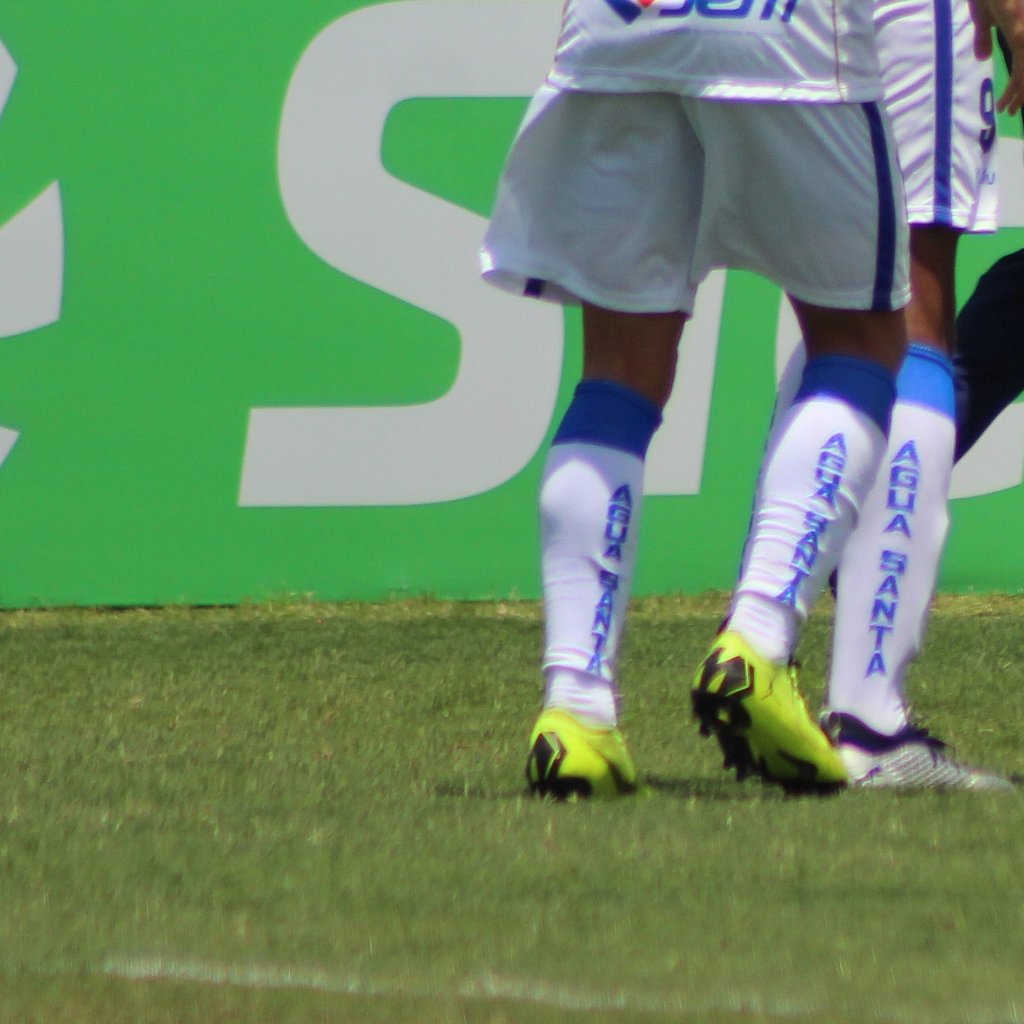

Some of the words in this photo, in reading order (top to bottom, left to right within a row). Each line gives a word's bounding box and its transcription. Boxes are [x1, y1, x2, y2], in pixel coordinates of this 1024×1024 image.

[813, 432, 847, 508] AGUA
[883, 439, 920, 538] AGUA
[604, 484, 632, 560] AGUA
[774, 511, 829, 607] SANTA
[586, 569, 619, 675] SANTA
[866, 550, 908, 678] SANTA
